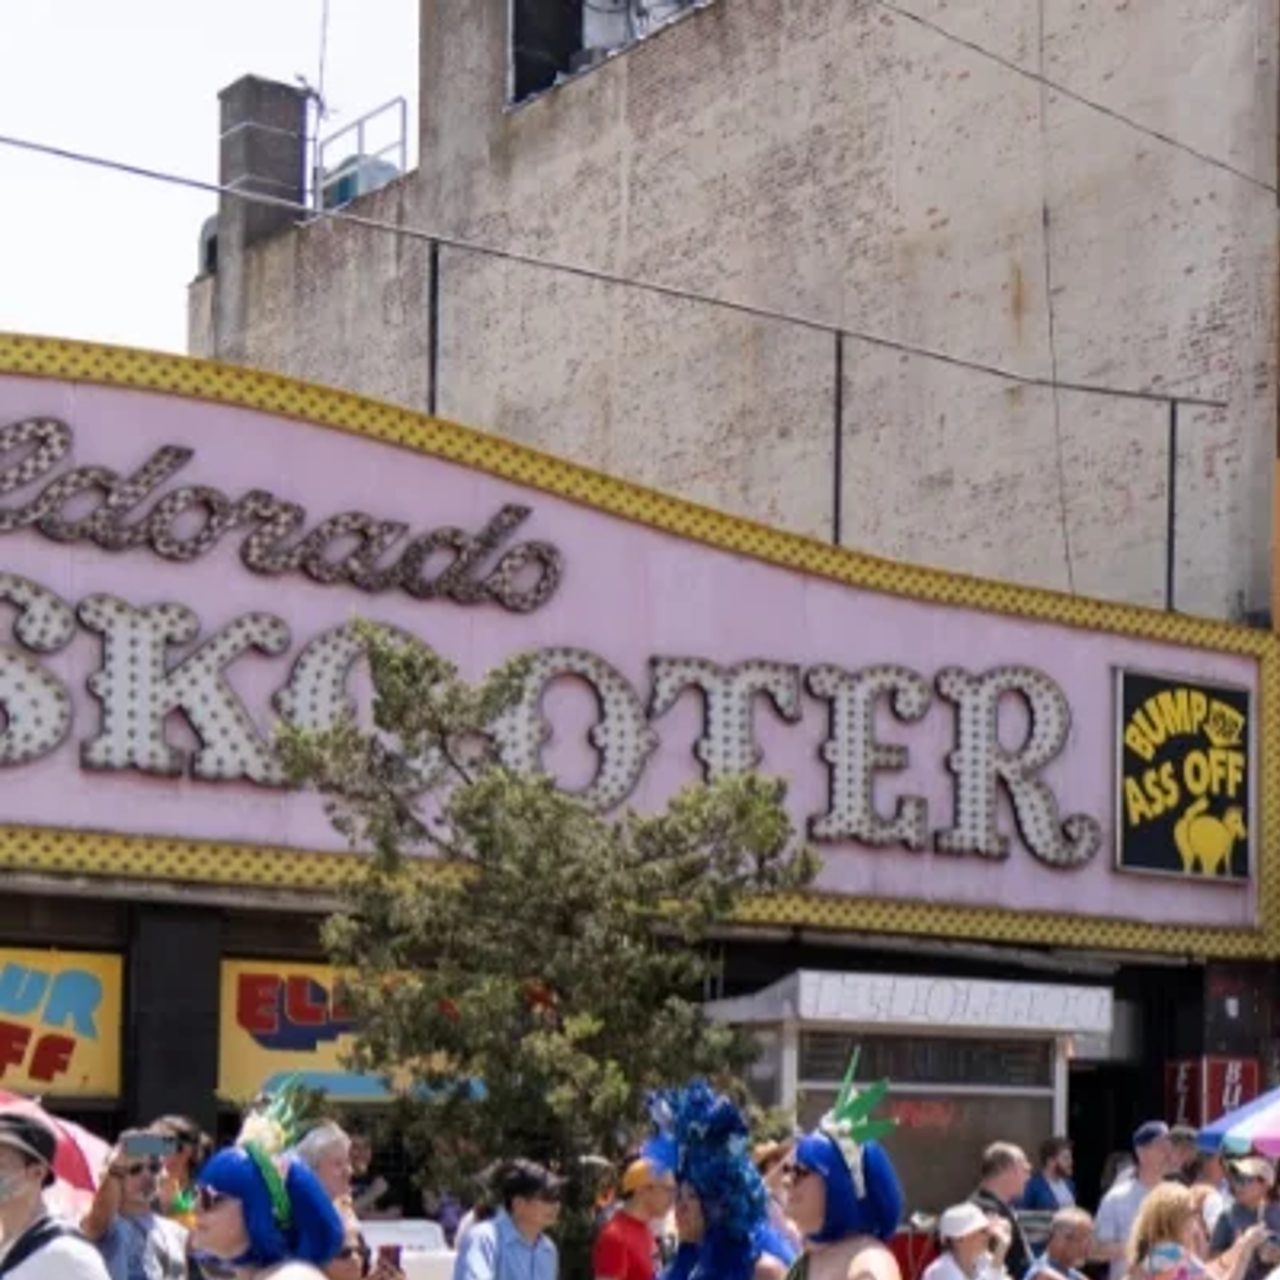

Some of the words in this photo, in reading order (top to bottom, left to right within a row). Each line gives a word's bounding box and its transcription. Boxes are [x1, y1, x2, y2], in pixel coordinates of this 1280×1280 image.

[1125, 688, 1207, 760] BUMP
[1124, 761, 1180, 826] ASS
[1183, 750, 1245, 797] OFF
